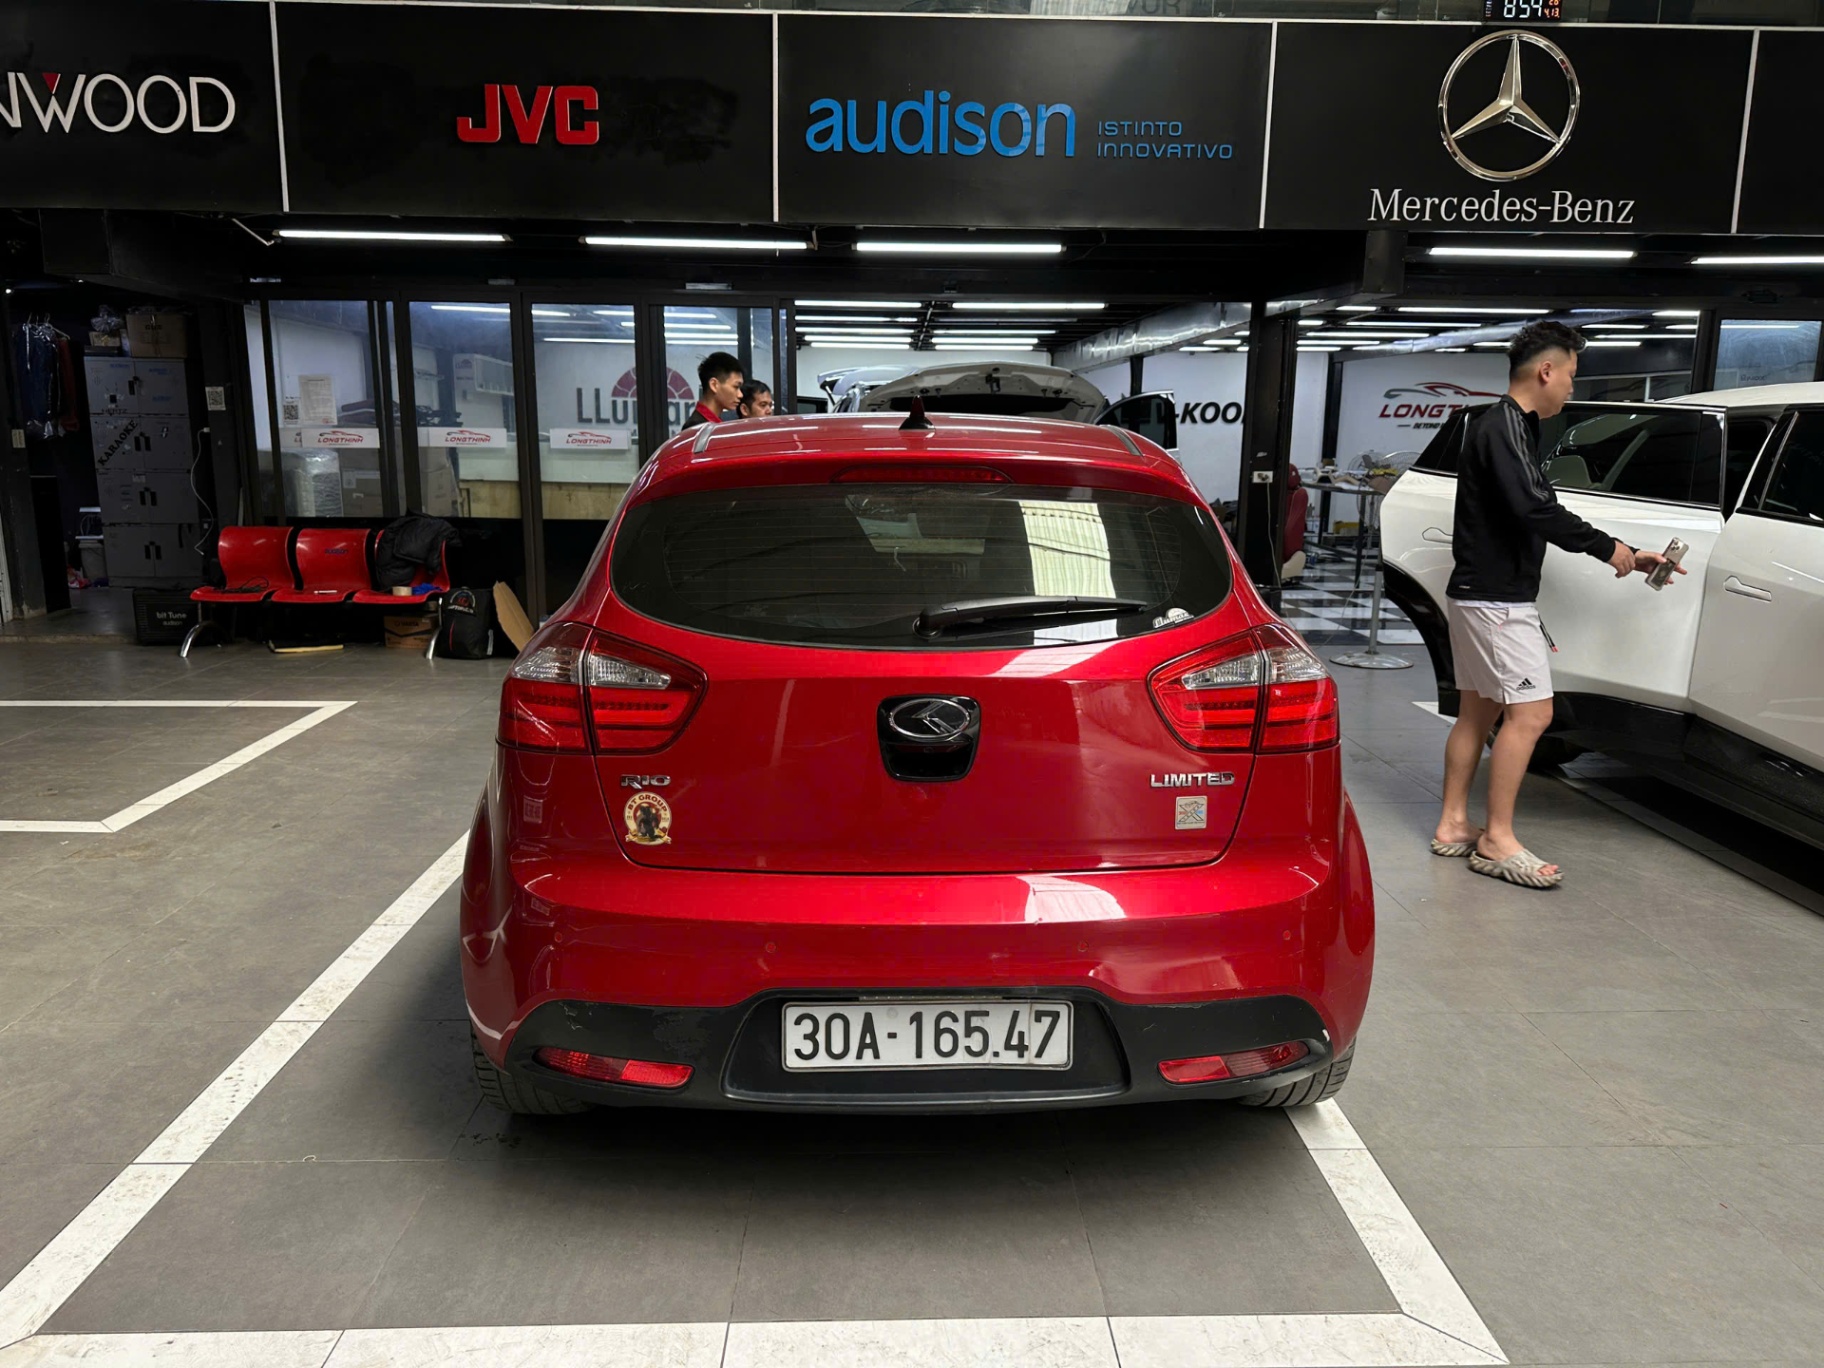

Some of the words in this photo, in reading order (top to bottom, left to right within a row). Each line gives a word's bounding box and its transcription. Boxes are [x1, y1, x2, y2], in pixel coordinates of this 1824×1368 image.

[458, 85, 599, 144] JVC
[806, 90, 1076, 156] audison
[1368, 188, 1635, 224] Mercedes-Benz
[97, 419, 138, 467] KARAOKE
[168, 611, 187, 619] Tune
[620, 774, 671, 789] RIO
[1150, 771, 1235, 787] LIMITED
[627, 798, 637, 811] BT
[638, 794, 667, 812] GROUP
[793, 1010, 1061, 1061] 30A-165.47
